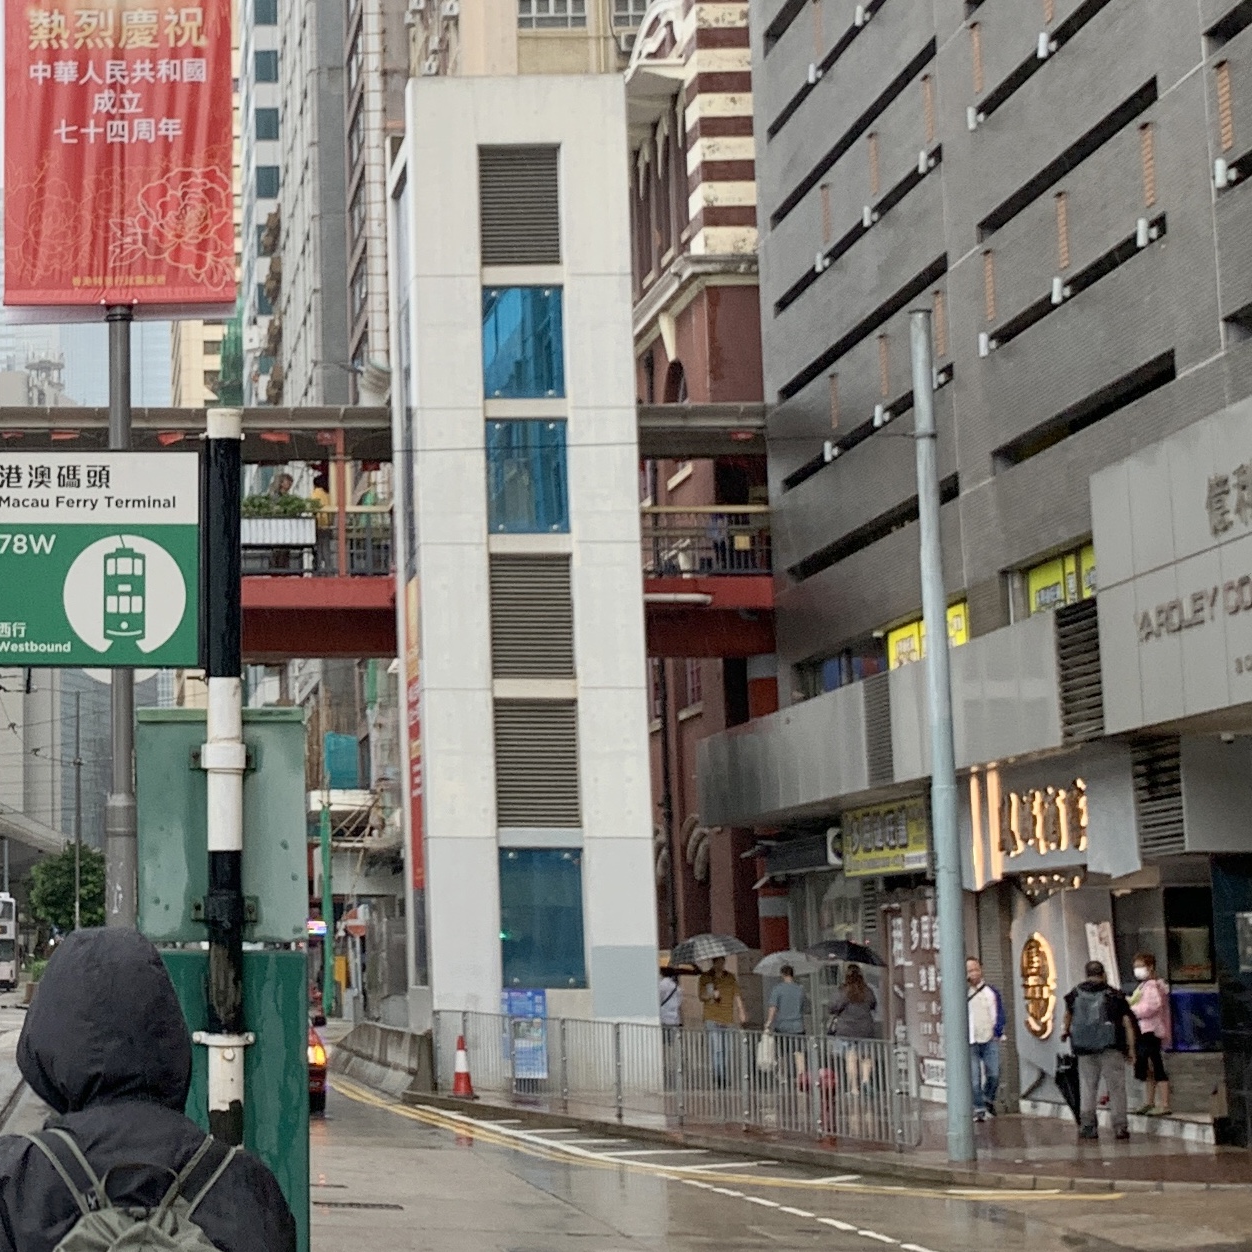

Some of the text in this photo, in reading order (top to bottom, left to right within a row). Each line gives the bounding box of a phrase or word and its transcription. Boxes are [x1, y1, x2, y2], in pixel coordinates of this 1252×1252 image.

[28, 7, 209, 50] 熱烈慶祝
[29, 58, 207, 85] 中華人民共和國
[92, 89, 143, 114] 成立
[54, 118, 183, 144] 七十四周年
[55, 496, 99, 511] Ferry
[104, 495, 176, 508] Terminal
